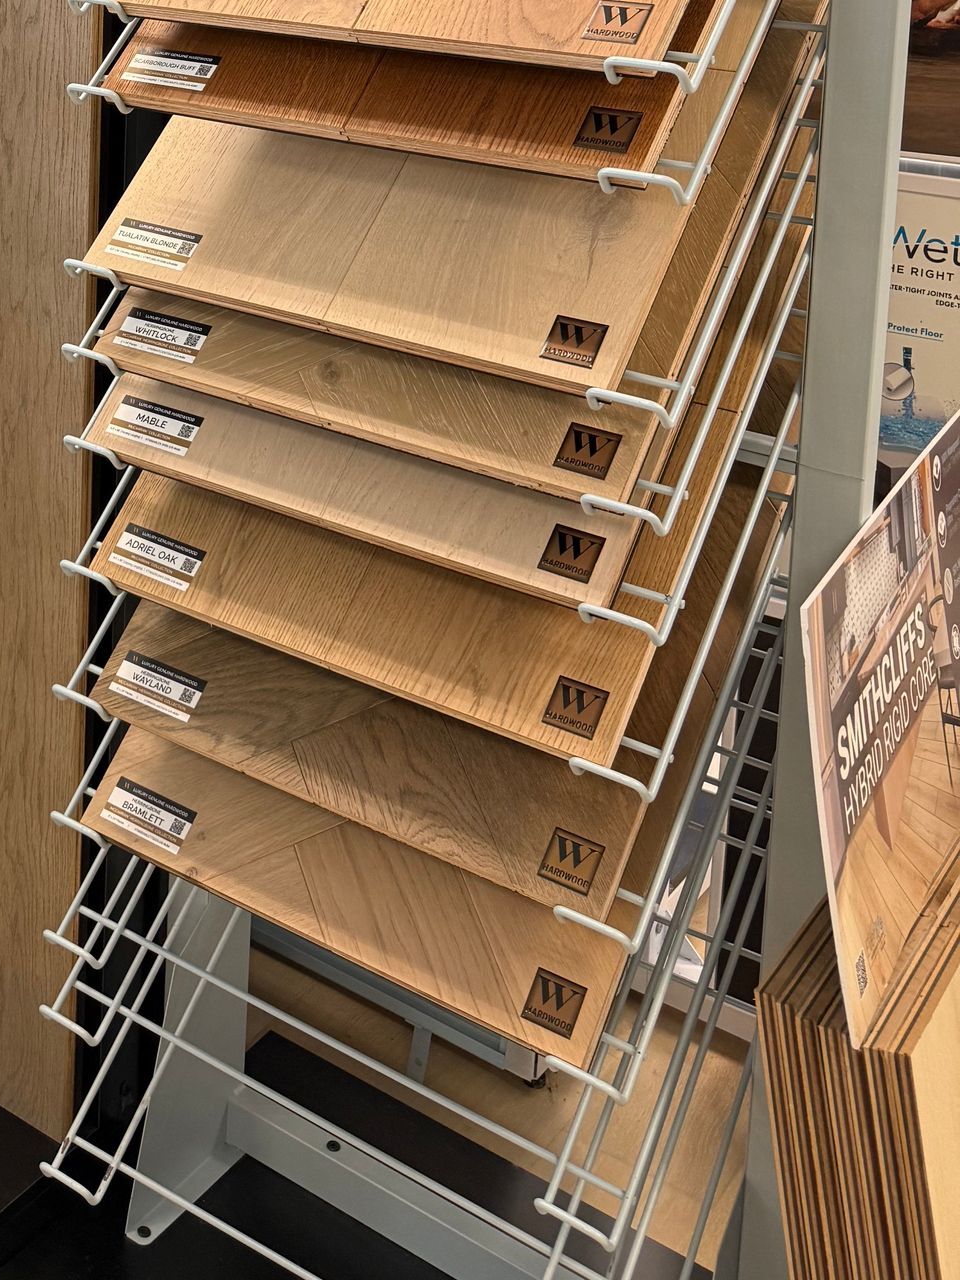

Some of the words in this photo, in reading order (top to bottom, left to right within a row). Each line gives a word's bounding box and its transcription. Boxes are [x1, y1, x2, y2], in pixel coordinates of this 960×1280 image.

[601, 4, 646, 27] W
[587, 27, 639, 40] HARDWOOD
[134, 58, 179, 70] SCARBOROUGH
[592, 112, 634, 136] W
[577, 135, 627, 148] HARDWOOD
[118, 230, 149, 243] TUALATIN
[150, 238, 179, 249] BLONDE
[910, 266, 954, 281] RIGHT
[890, 284, 925, 295] TER-TIGHT
[926, 290, 952, 299] JOINTS
[135, 326, 179, 343] WHITLOCK
[559, 321, 600, 348] W
[887, 322, 918, 334] Protect
[920, 327, 943, 338] Floor
[544, 346, 592, 362] HARDWOOD
[136, 413, 168, 429] MABLE
[573, 428, 615, 458] W
[557, 455, 605, 472] HARDWOOD
[125, 538, 156, 557] ADRIEL
[158, 551, 179, 565] OAK
[557, 531, 601, 561] W
[542, 558, 589, 577] HARDWOOD
[132, 672, 172, 695] WAYLAND
[837, 601, 926, 780] SMITHCLIFFS
[560, 684, 604, 714] W
[546, 710, 593, 733] HARDWOOD
[843, 737, 884, 835] HYBRID
[882, 690, 911, 762] RIGID
[911, 645, 936, 712] CORE
[122, 800, 165, 826] BRAMLETT
[556, 834, 600, 869] W
[542, 862, 589, 888] HARDWOOD
[540, 975, 582, 1011] W
[525, 1005, 572, 1032] HARDWOOD
